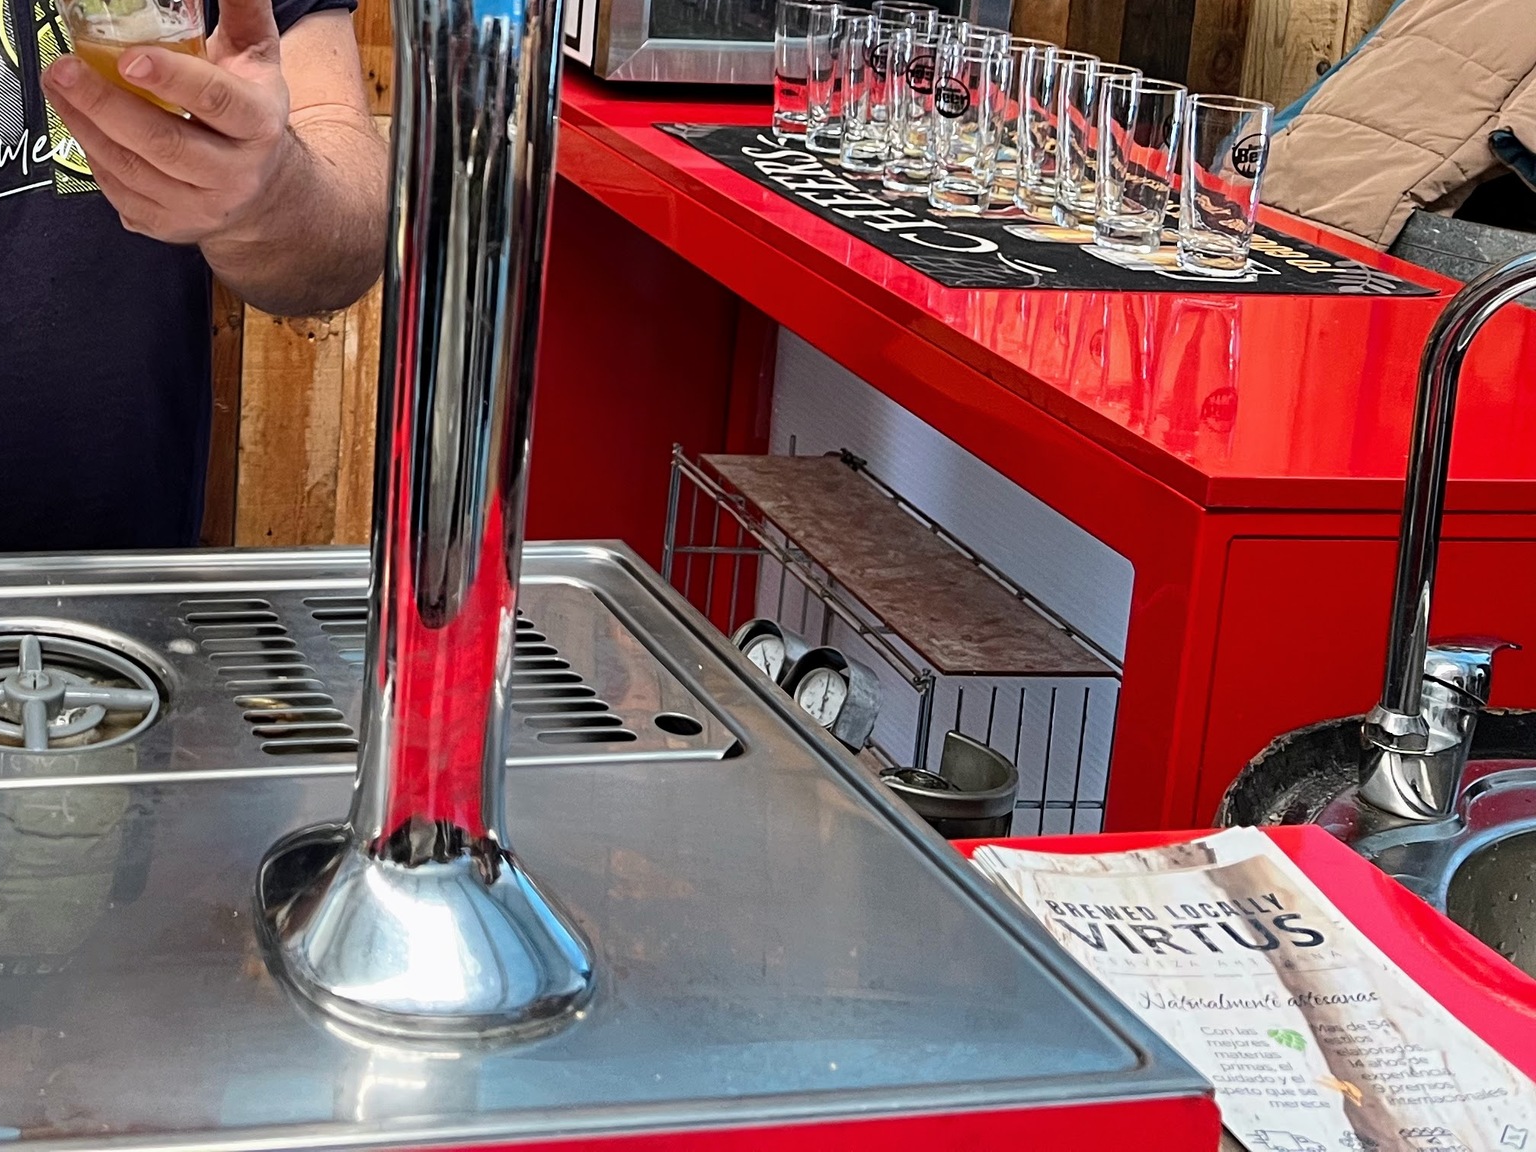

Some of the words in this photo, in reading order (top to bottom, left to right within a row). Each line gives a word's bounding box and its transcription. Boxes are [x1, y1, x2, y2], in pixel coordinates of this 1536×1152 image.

[741, 142, 1000, 253] CHEERS
[1044, 898, 1157, 921] BREWED
[1163, 892, 1286, 921] LOCALLY
[1053, 912, 1326, 956] VIRTUS
[1137, 990, 1281, 1012] Naturalmente
[1287, 990, 1379, 1011] artesanas
[1200, 1026, 1233, 1037] Con
[1237, 1026, 1259, 1036] las
[1346, 1021, 1366, 1032] de
[1206, 1039, 1271, 1049] mejores
[1323, 1034, 1374, 1045] estilos
[1214, 1051, 1282, 1060] materias
[1219, 1062, 1277, 1073] primas,
[1279, 1062, 1294, 1072] el
[1368, 1056, 1407, 1068] años
[1212, 1074, 1275, 1084] cuidado
[1278, 1075, 1287, 1086] y
[1291, 1074, 1306, 1084] el
[1265, 1088, 1296, 1098] que
[1298, 1088, 1318, 1097] se
[1389, 1080, 1456, 1095] premios
[1387, 1087, 1509, 1106] internacionales
[1269, 1100, 1331, 1109] merece
